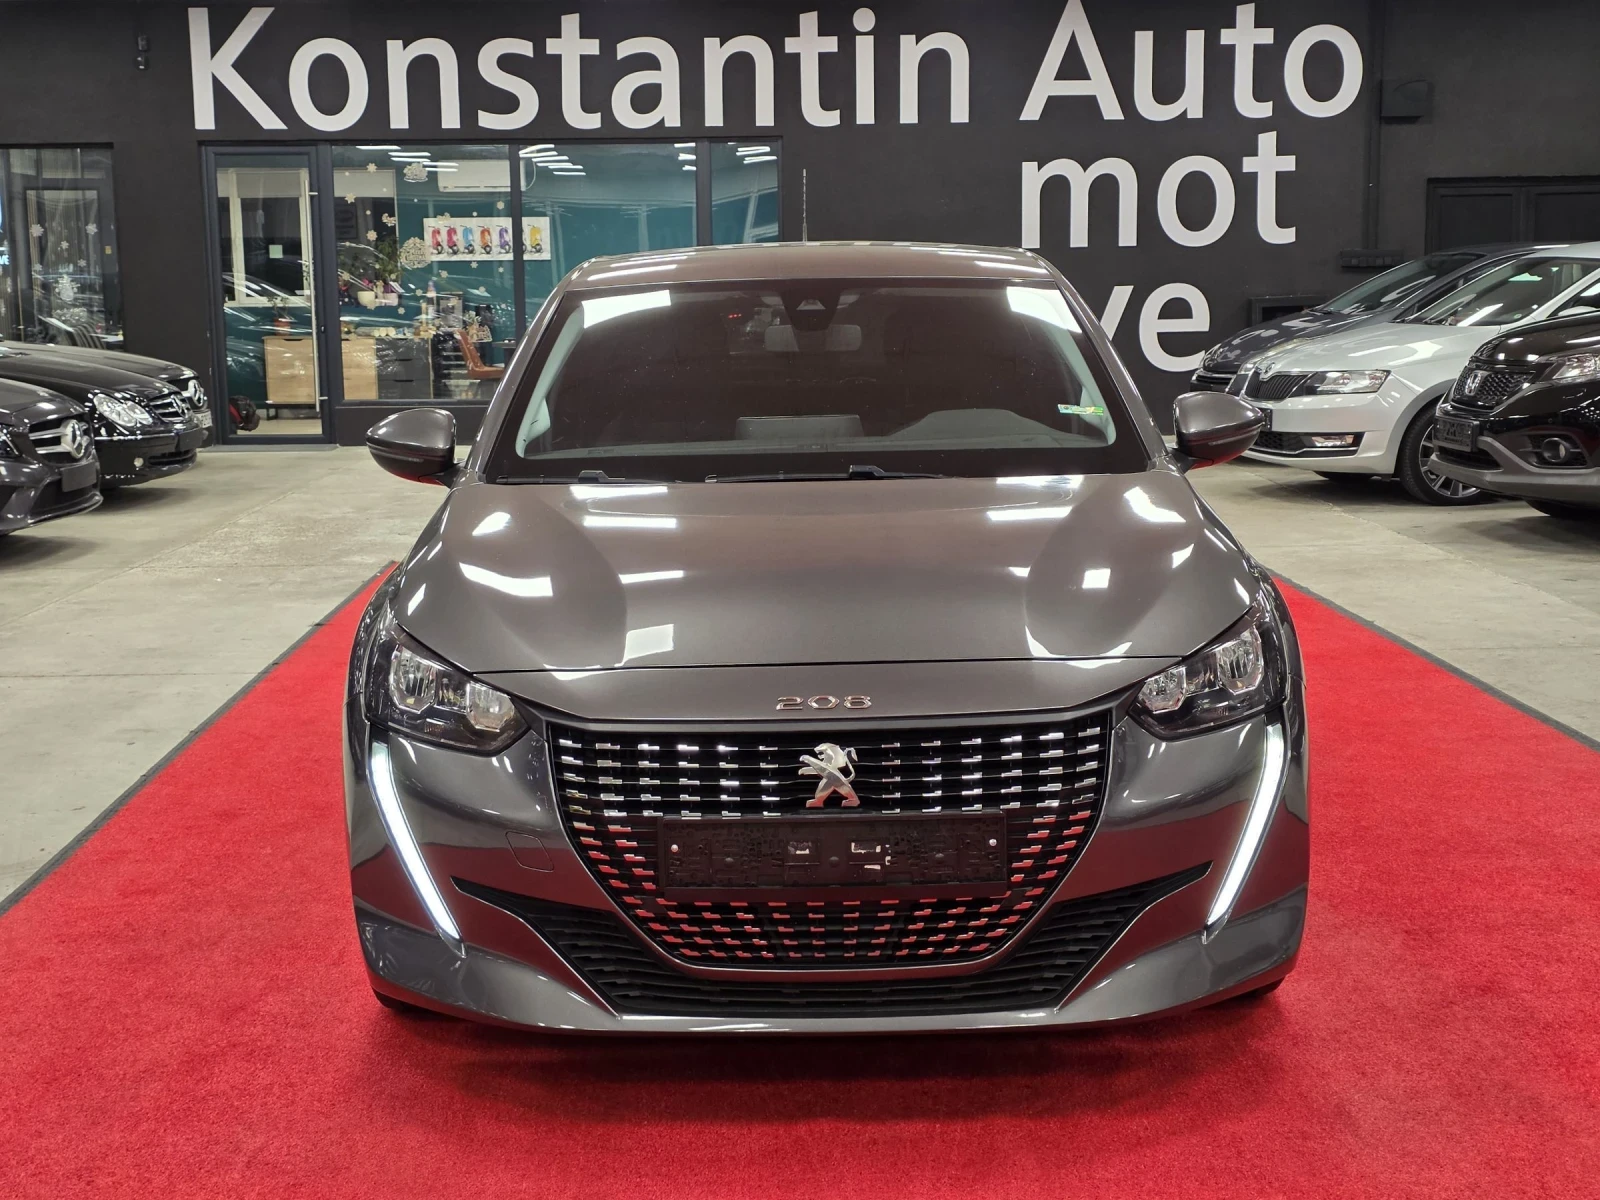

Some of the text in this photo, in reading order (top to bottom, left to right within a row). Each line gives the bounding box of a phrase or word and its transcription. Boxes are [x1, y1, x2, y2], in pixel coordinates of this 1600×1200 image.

[188, 0, 1364, 132] Konstantin Auto
[1021, 130, 1297, 249] mot
[775, 694, 873, 711] 208
